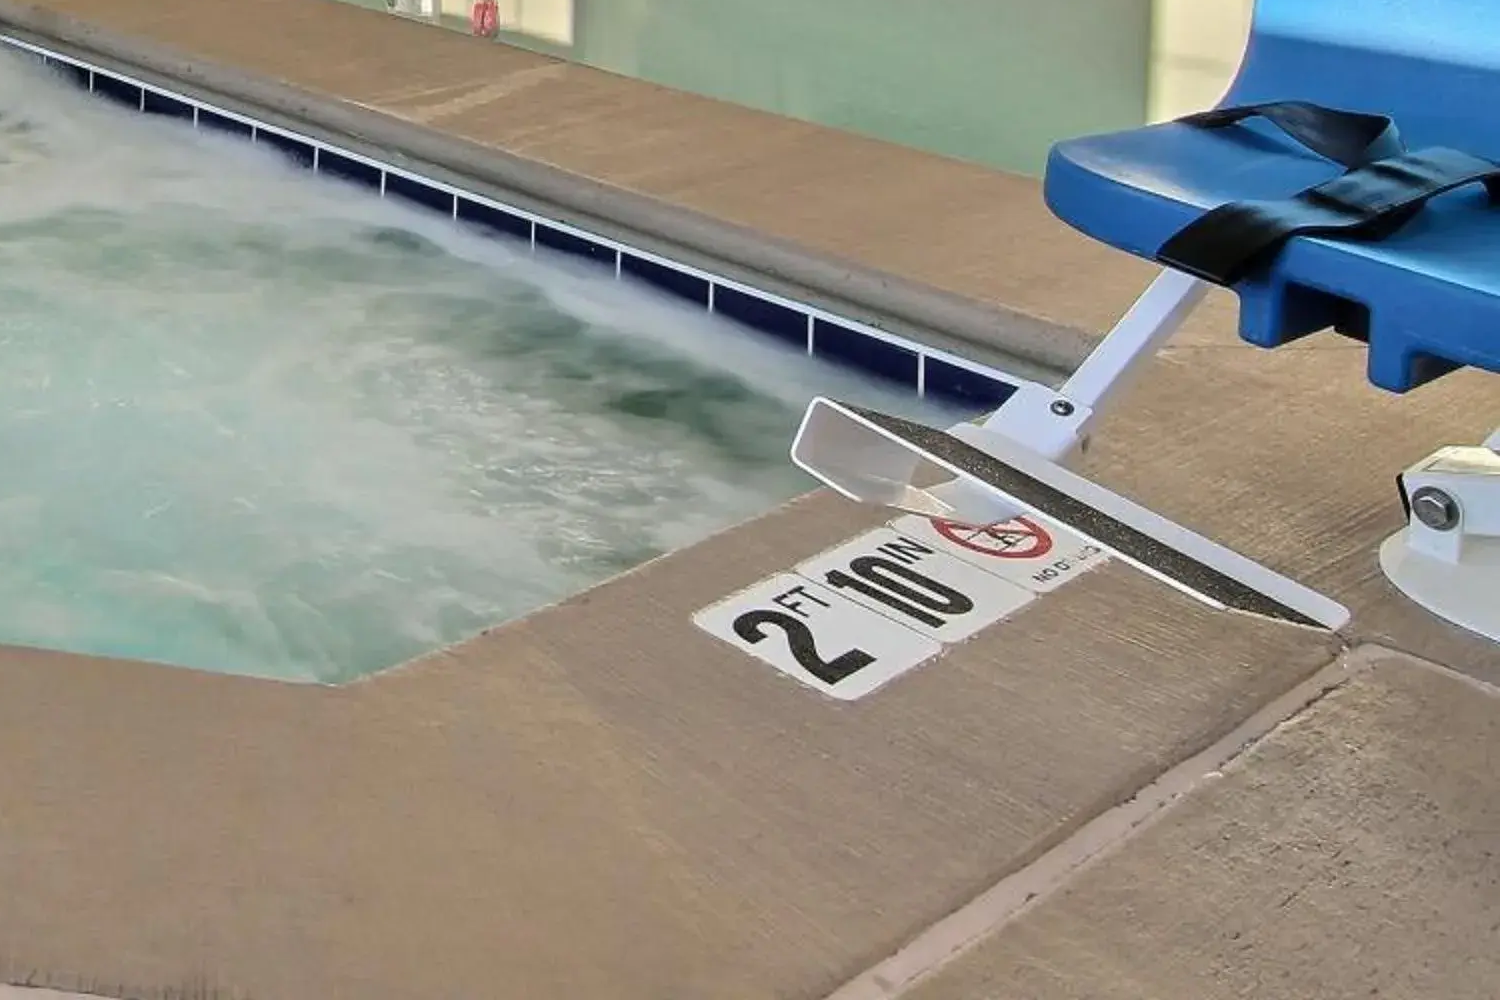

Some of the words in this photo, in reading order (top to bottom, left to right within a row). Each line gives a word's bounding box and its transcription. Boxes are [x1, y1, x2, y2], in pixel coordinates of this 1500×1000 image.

[877, 537, 935, 565] IN
[824, 555, 974, 630] 10
[732, 609, 877, 685] 2
